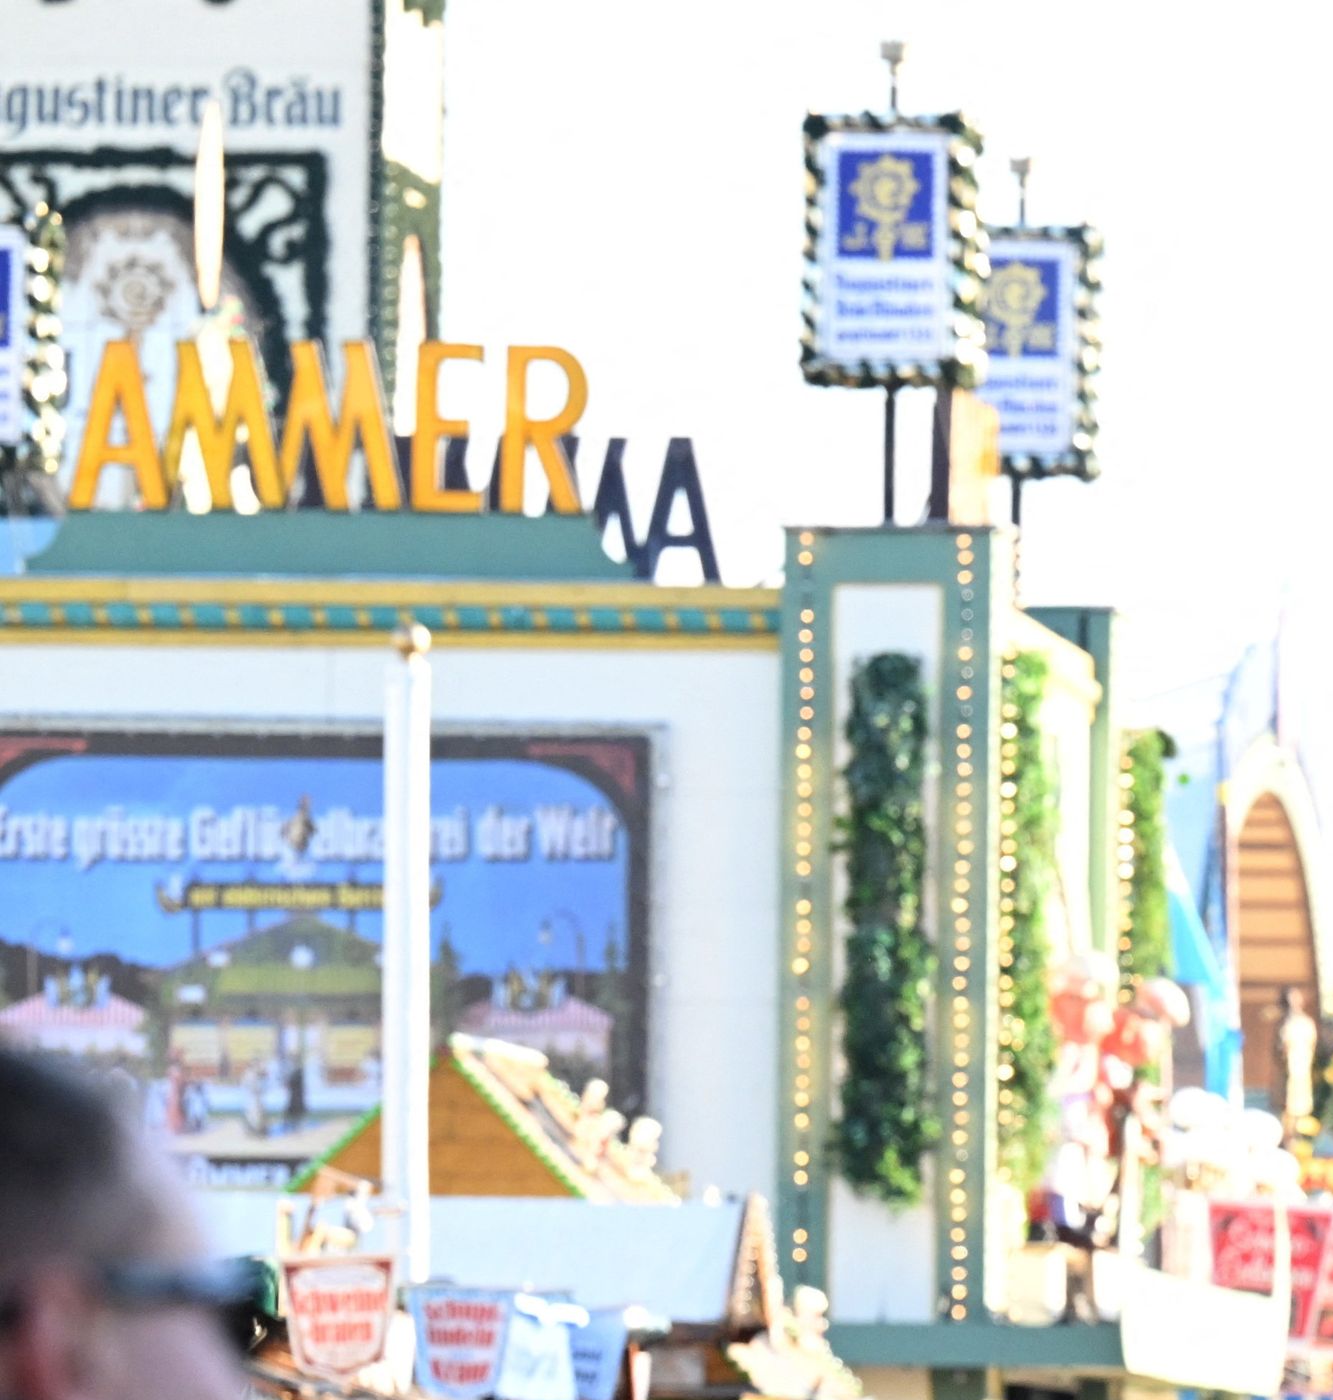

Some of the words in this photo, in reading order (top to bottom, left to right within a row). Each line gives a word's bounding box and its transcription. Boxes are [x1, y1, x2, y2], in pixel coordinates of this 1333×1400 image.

[0, 74, 208, 140] gustiner
[223, 66, 341, 128] Bräu
[68, 338, 590, 512] AMMER
[476, 805, 534, 861] der
